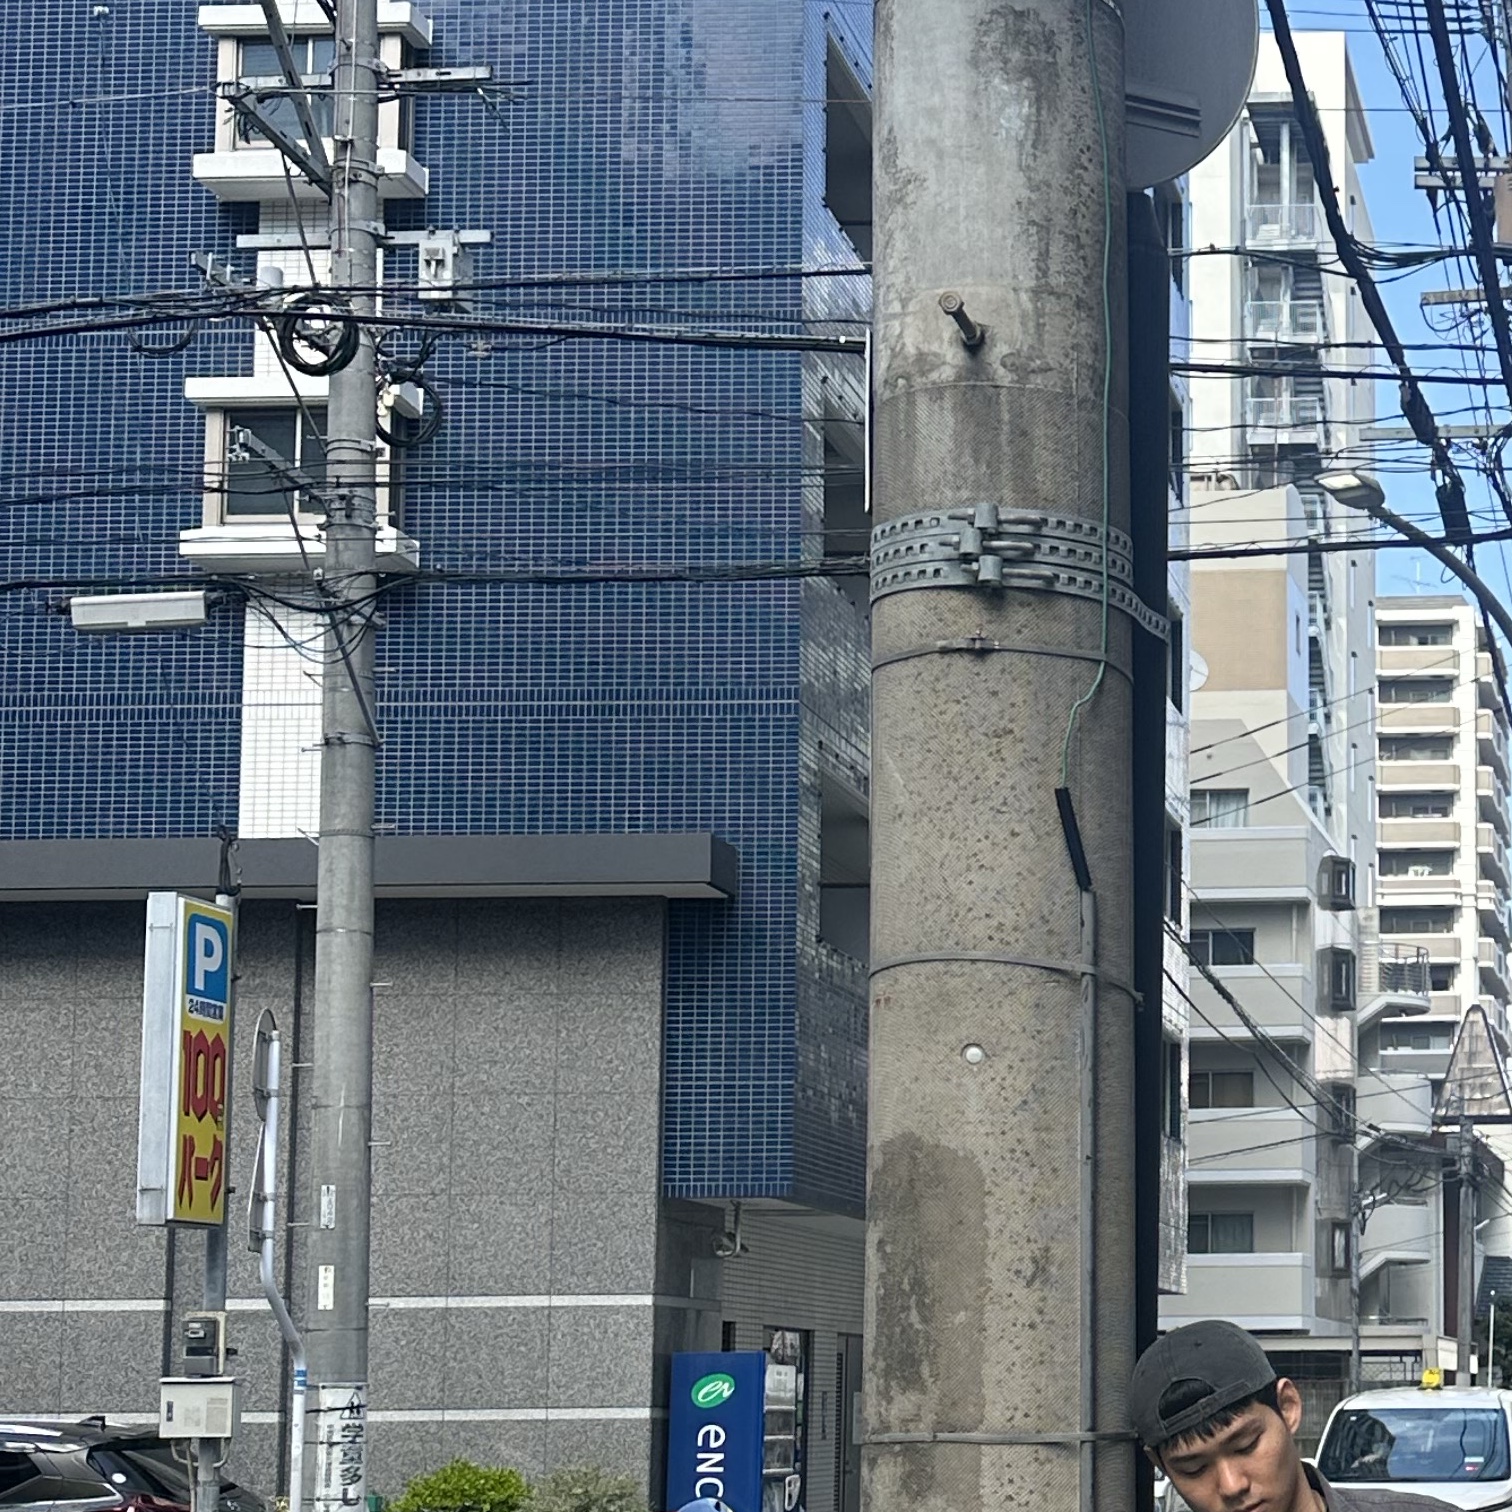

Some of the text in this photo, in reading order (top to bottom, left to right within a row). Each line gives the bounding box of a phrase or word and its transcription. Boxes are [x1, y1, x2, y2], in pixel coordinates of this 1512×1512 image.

[194, 922, 223, 991] P
[178, 1134, 223, 1211] パーク
